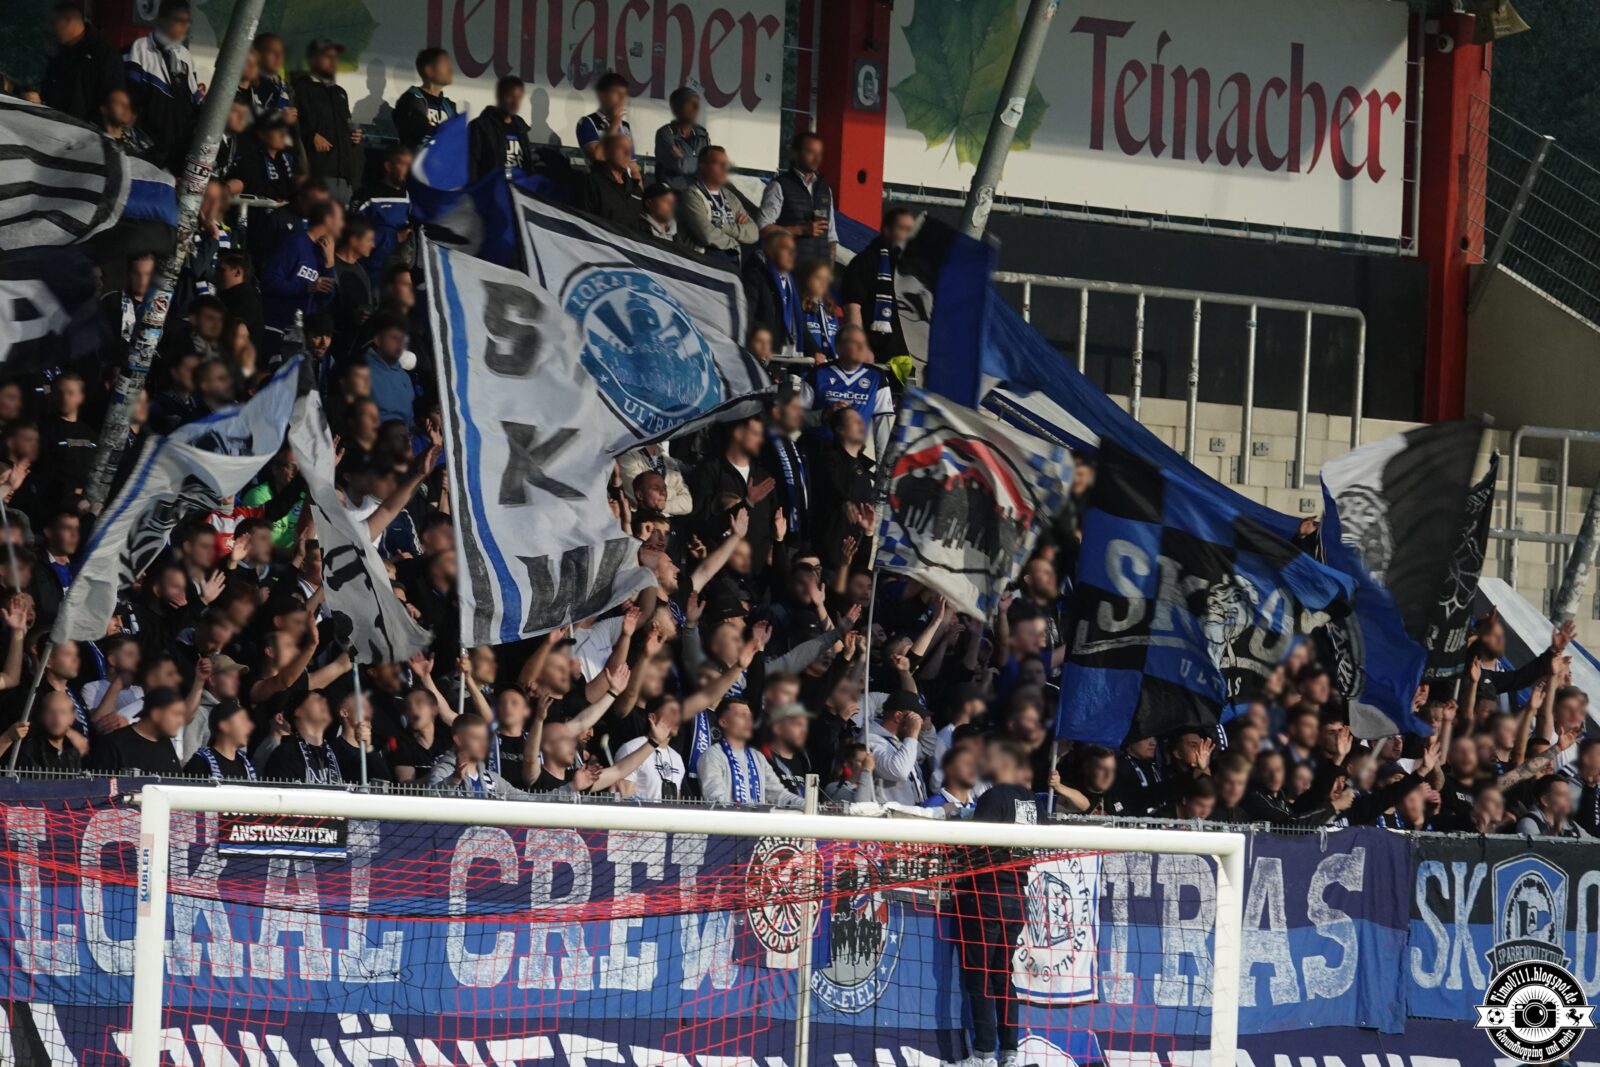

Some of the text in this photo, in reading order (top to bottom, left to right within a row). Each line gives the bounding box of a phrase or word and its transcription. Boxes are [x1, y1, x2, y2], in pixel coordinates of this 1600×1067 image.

[1070, 16, 1402, 183] Teinacher
[571, 273, 640, 309] LOKAL
[229, 824, 338, 844] ANSTOSSZEITEN!
[446, 826, 740, 992] CREW
[1411, 859, 1488, 992] SK
